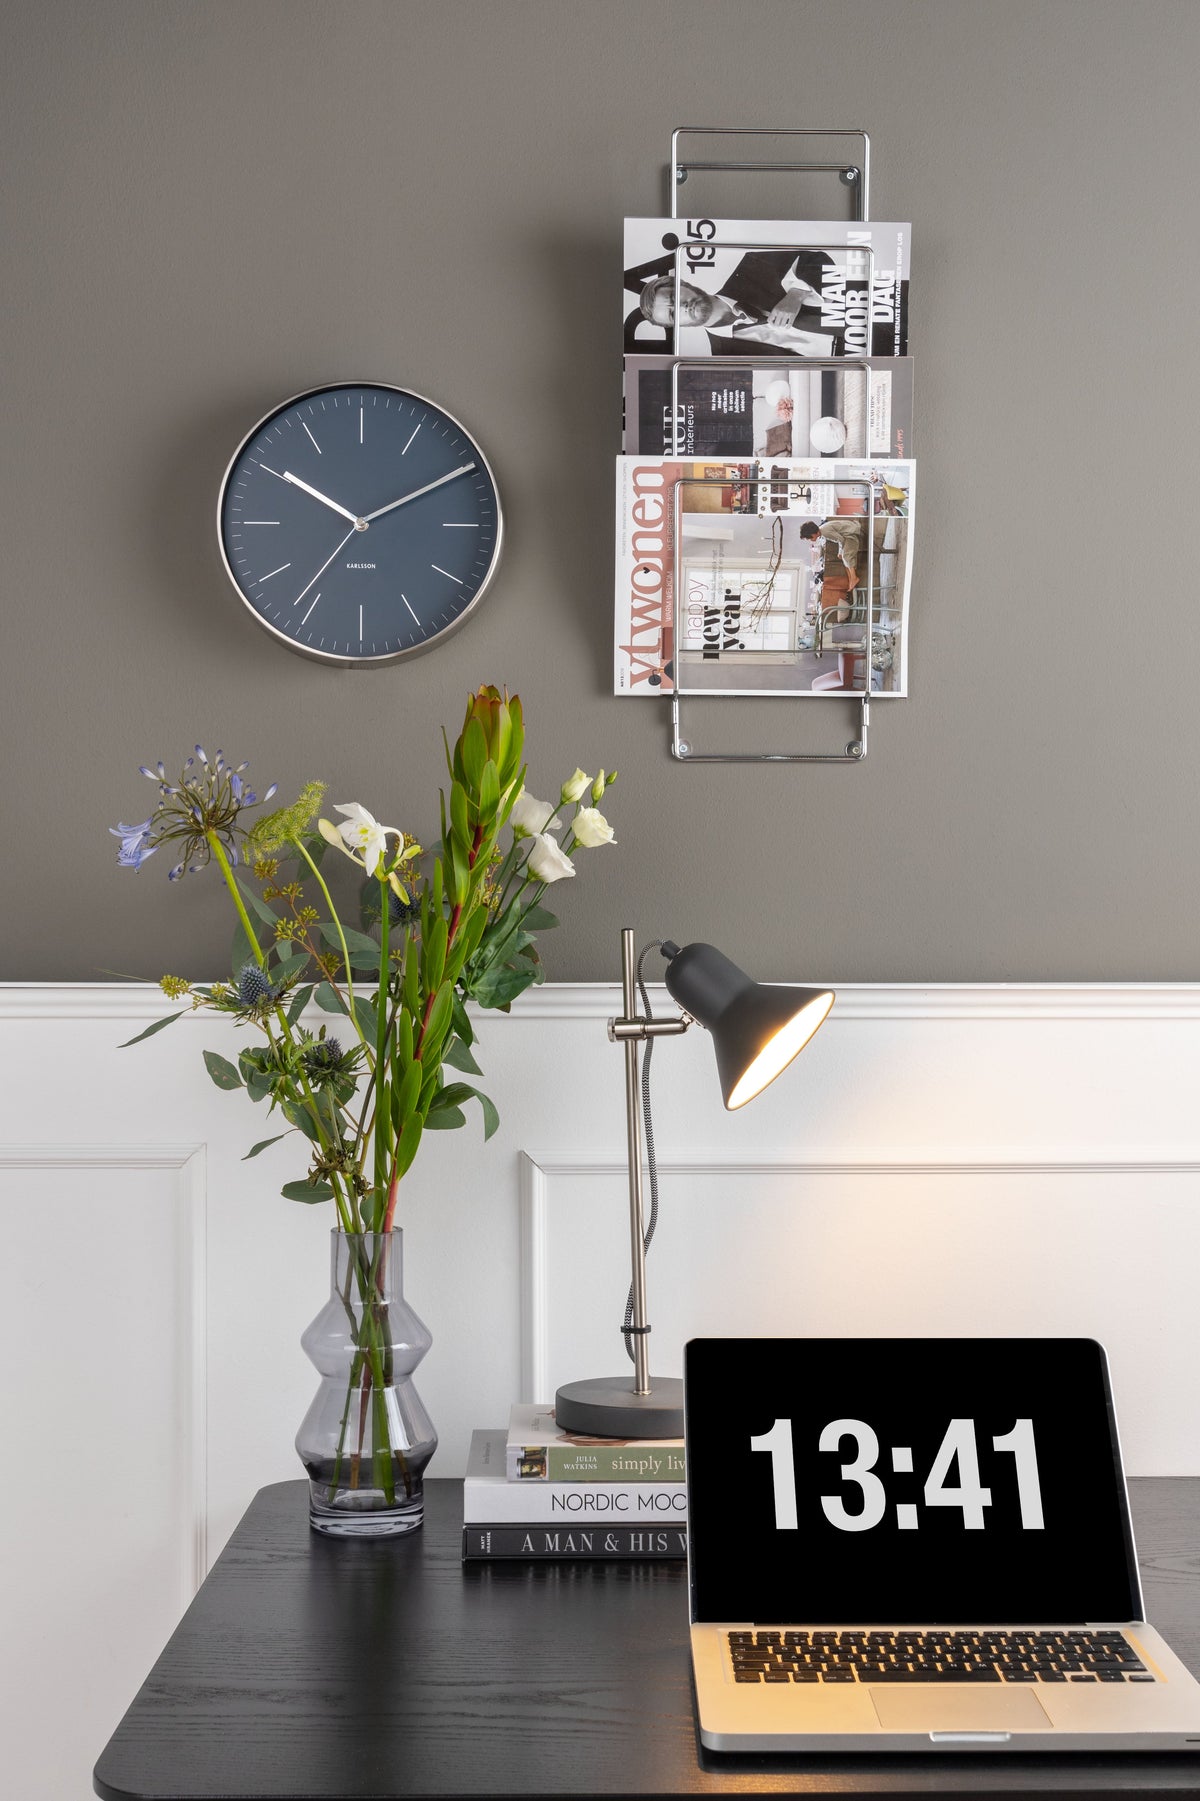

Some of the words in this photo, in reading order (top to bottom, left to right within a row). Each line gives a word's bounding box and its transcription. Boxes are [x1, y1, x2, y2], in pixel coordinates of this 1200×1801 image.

[686, 219, 717, 274] 195
[821, 264, 846, 327] MAN
[844, 290, 869, 356] VOOR
[872, 270, 896, 323] DAG
[618, 462, 666, 689] vtwonen
[683, 578, 709, 640] happy
[702, 605, 721, 660] new
[723, 588, 745, 650] year
[611, 1455, 662, 1475] simply
[750, 1418, 1045, 1532] 13:41
[552, 1493, 629, 1511] NORDIC
[521, 1533, 535, 1552] A
[544, 1533, 594, 1552] MAN
[604, 1533, 620, 1552] &
[630, 1533, 669, 1552] HIS
